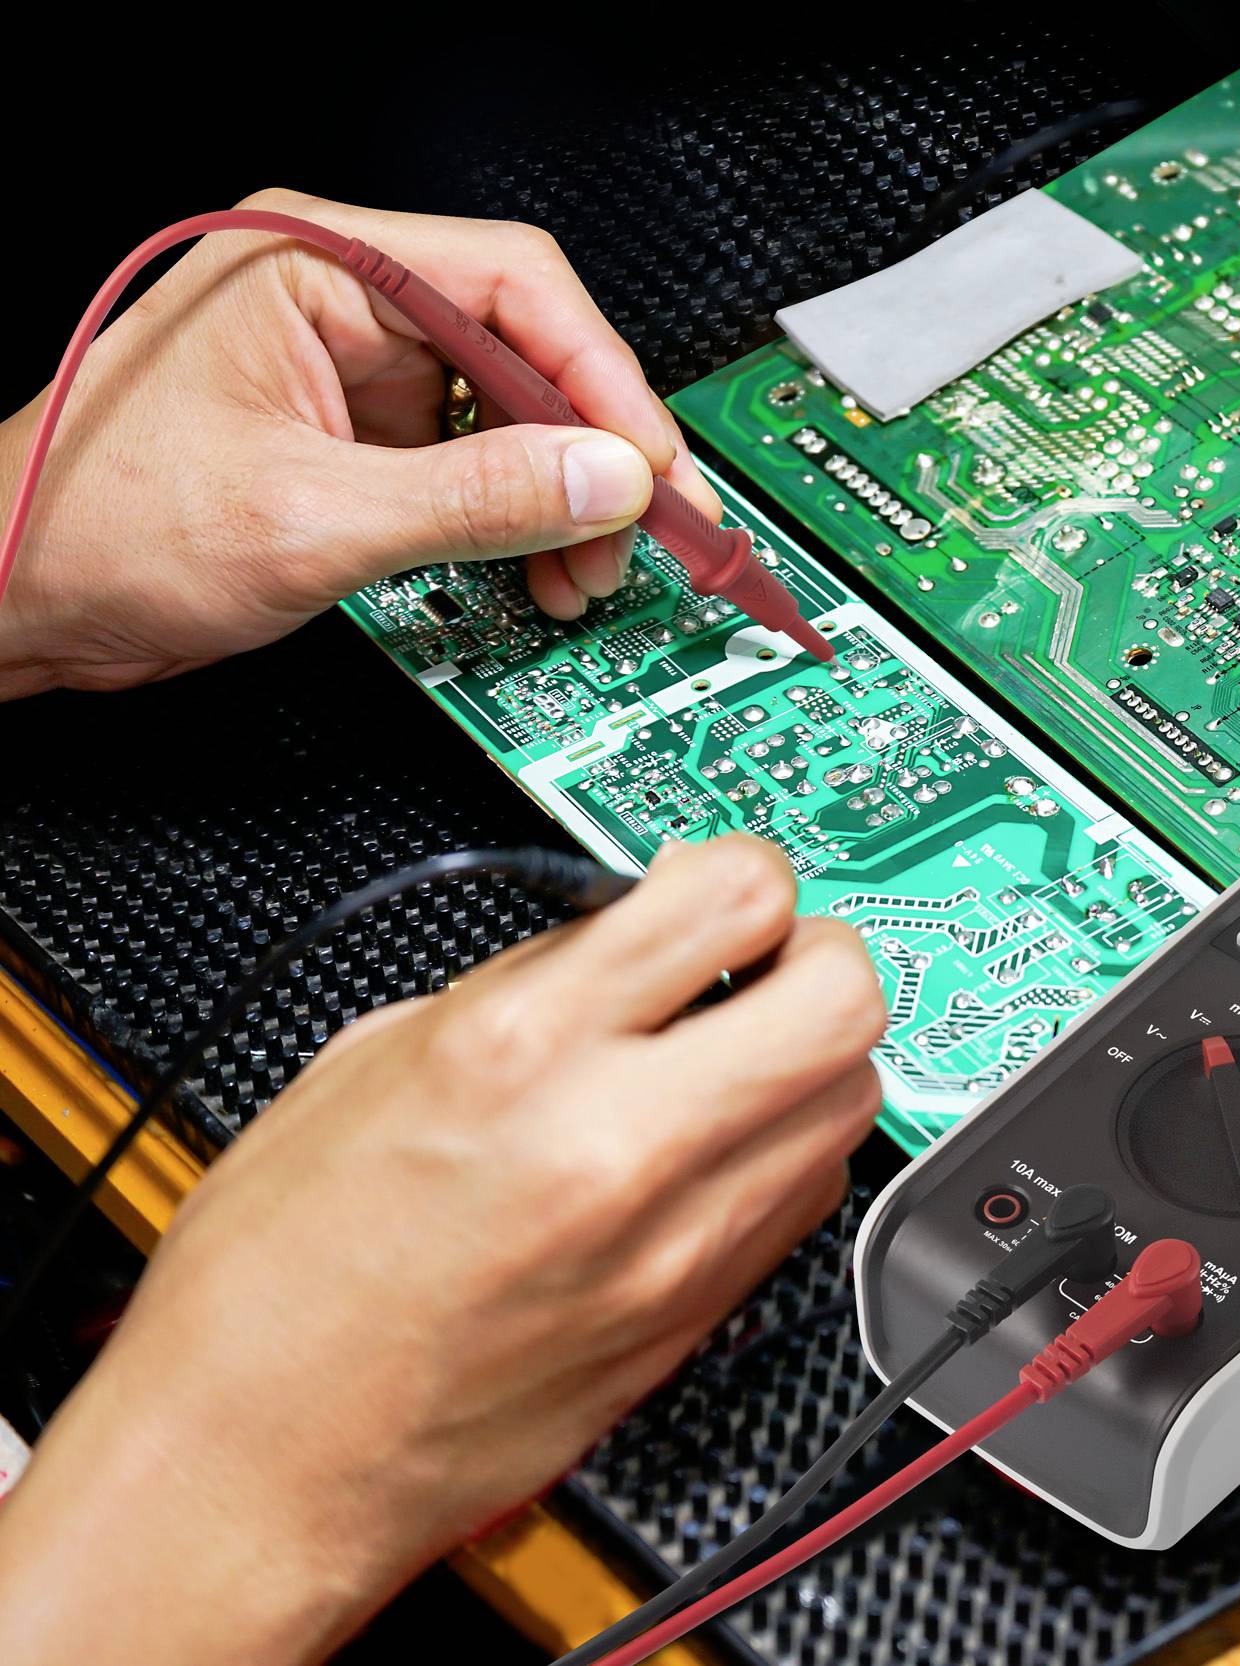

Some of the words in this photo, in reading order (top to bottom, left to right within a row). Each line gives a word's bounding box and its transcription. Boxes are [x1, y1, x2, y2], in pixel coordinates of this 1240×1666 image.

[1107, 1046, 1134, 1064] OFF
[1010, 1159, 1034, 1180] 10A
[1033, 1176, 1062, 1197] max
[1114, 1222, 1138, 1245] OM
